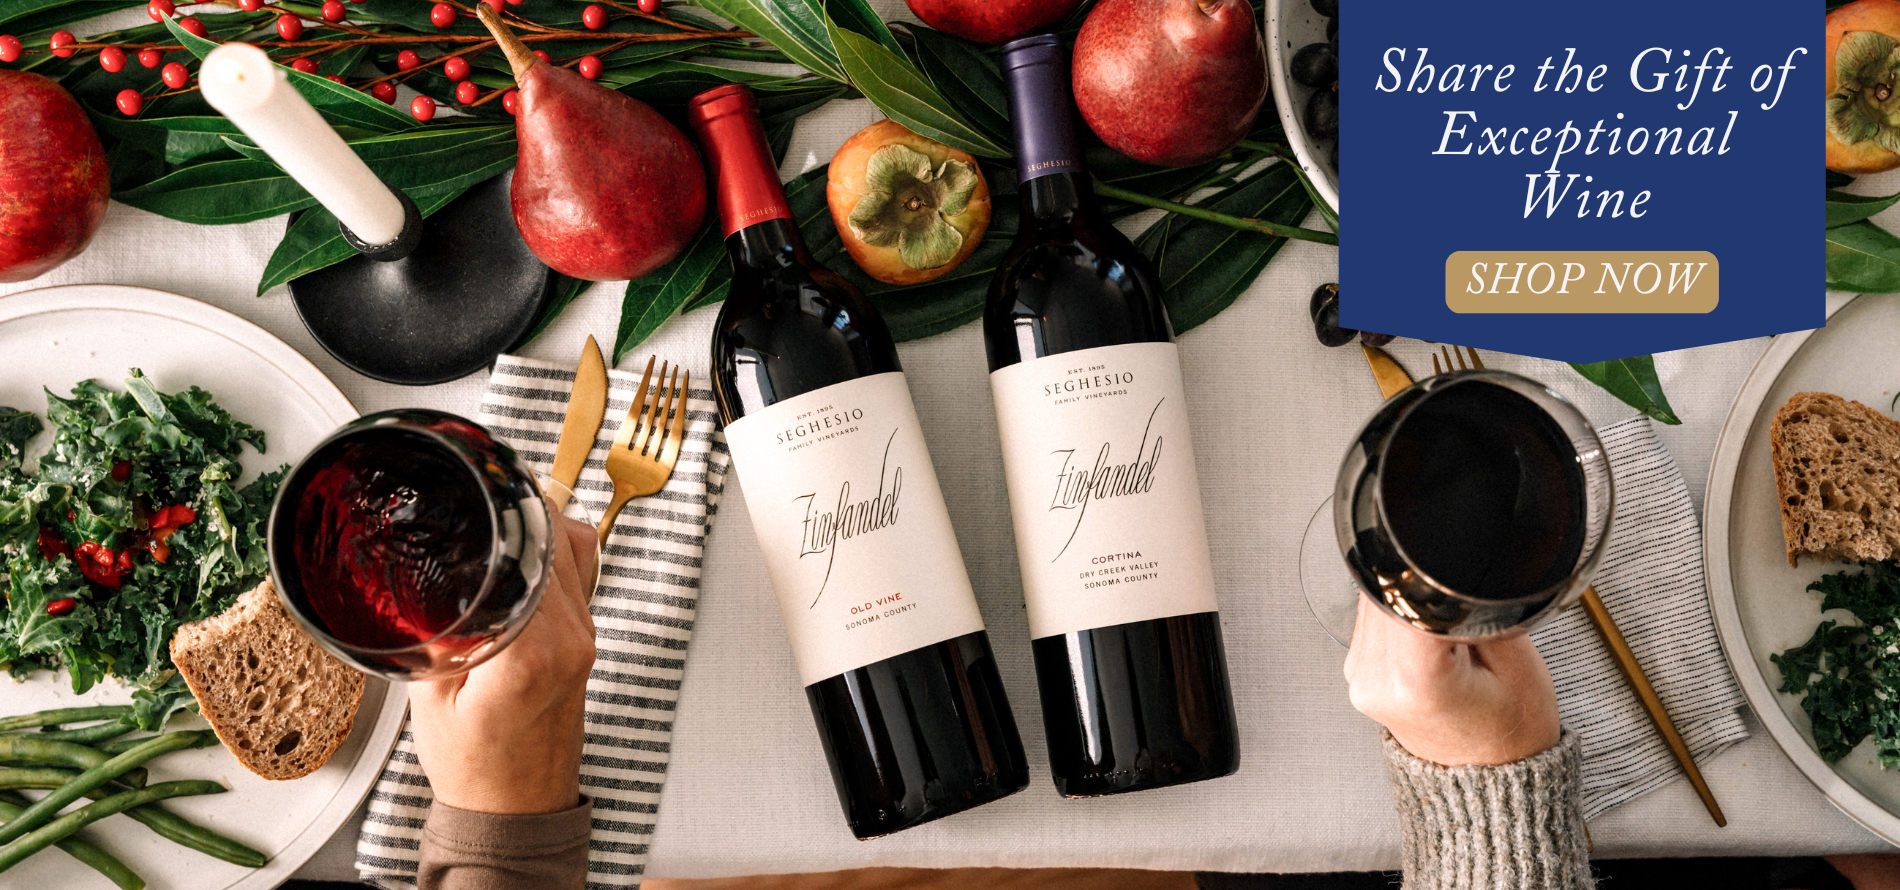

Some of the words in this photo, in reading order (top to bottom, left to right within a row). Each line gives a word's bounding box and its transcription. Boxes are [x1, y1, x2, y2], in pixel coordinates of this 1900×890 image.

[1027, 159, 1072, 173] SEGHESIO
[739, 206, 783, 221] SEGHESIO
[1044, 372, 1134, 396] SEGHESIO
[1054, 396, 1081, 405] FAMILY
[1085, 389, 1128, 400] VINEYARDS
[796, 411, 814, 420] EST.
[776, 408, 864, 444] SEGHESIO
[788, 440, 813, 452] FAMILY
[817, 426, 859, 442] VINEYARDS
[1049, 397, 1165, 563] Zinfandel
[792, 427, 902, 609] Zinfandel
[1091, 551, 1142, 565] CORTINA
[1079, 570, 1095, 579] DRY
[1098, 566, 1126, 576] CREEK
[1129, 562, 1159, 572] VALLEY
[1084, 578, 1121, 589] SONOMA
[1125, 573, 1158, 583] COUNTY
[850, 601, 872, 615] OLD
[876, 592, 902, 606] VINE
[845, 614, 880, 630] SONOMA
[884, 602, 917, 618] COUNTY
